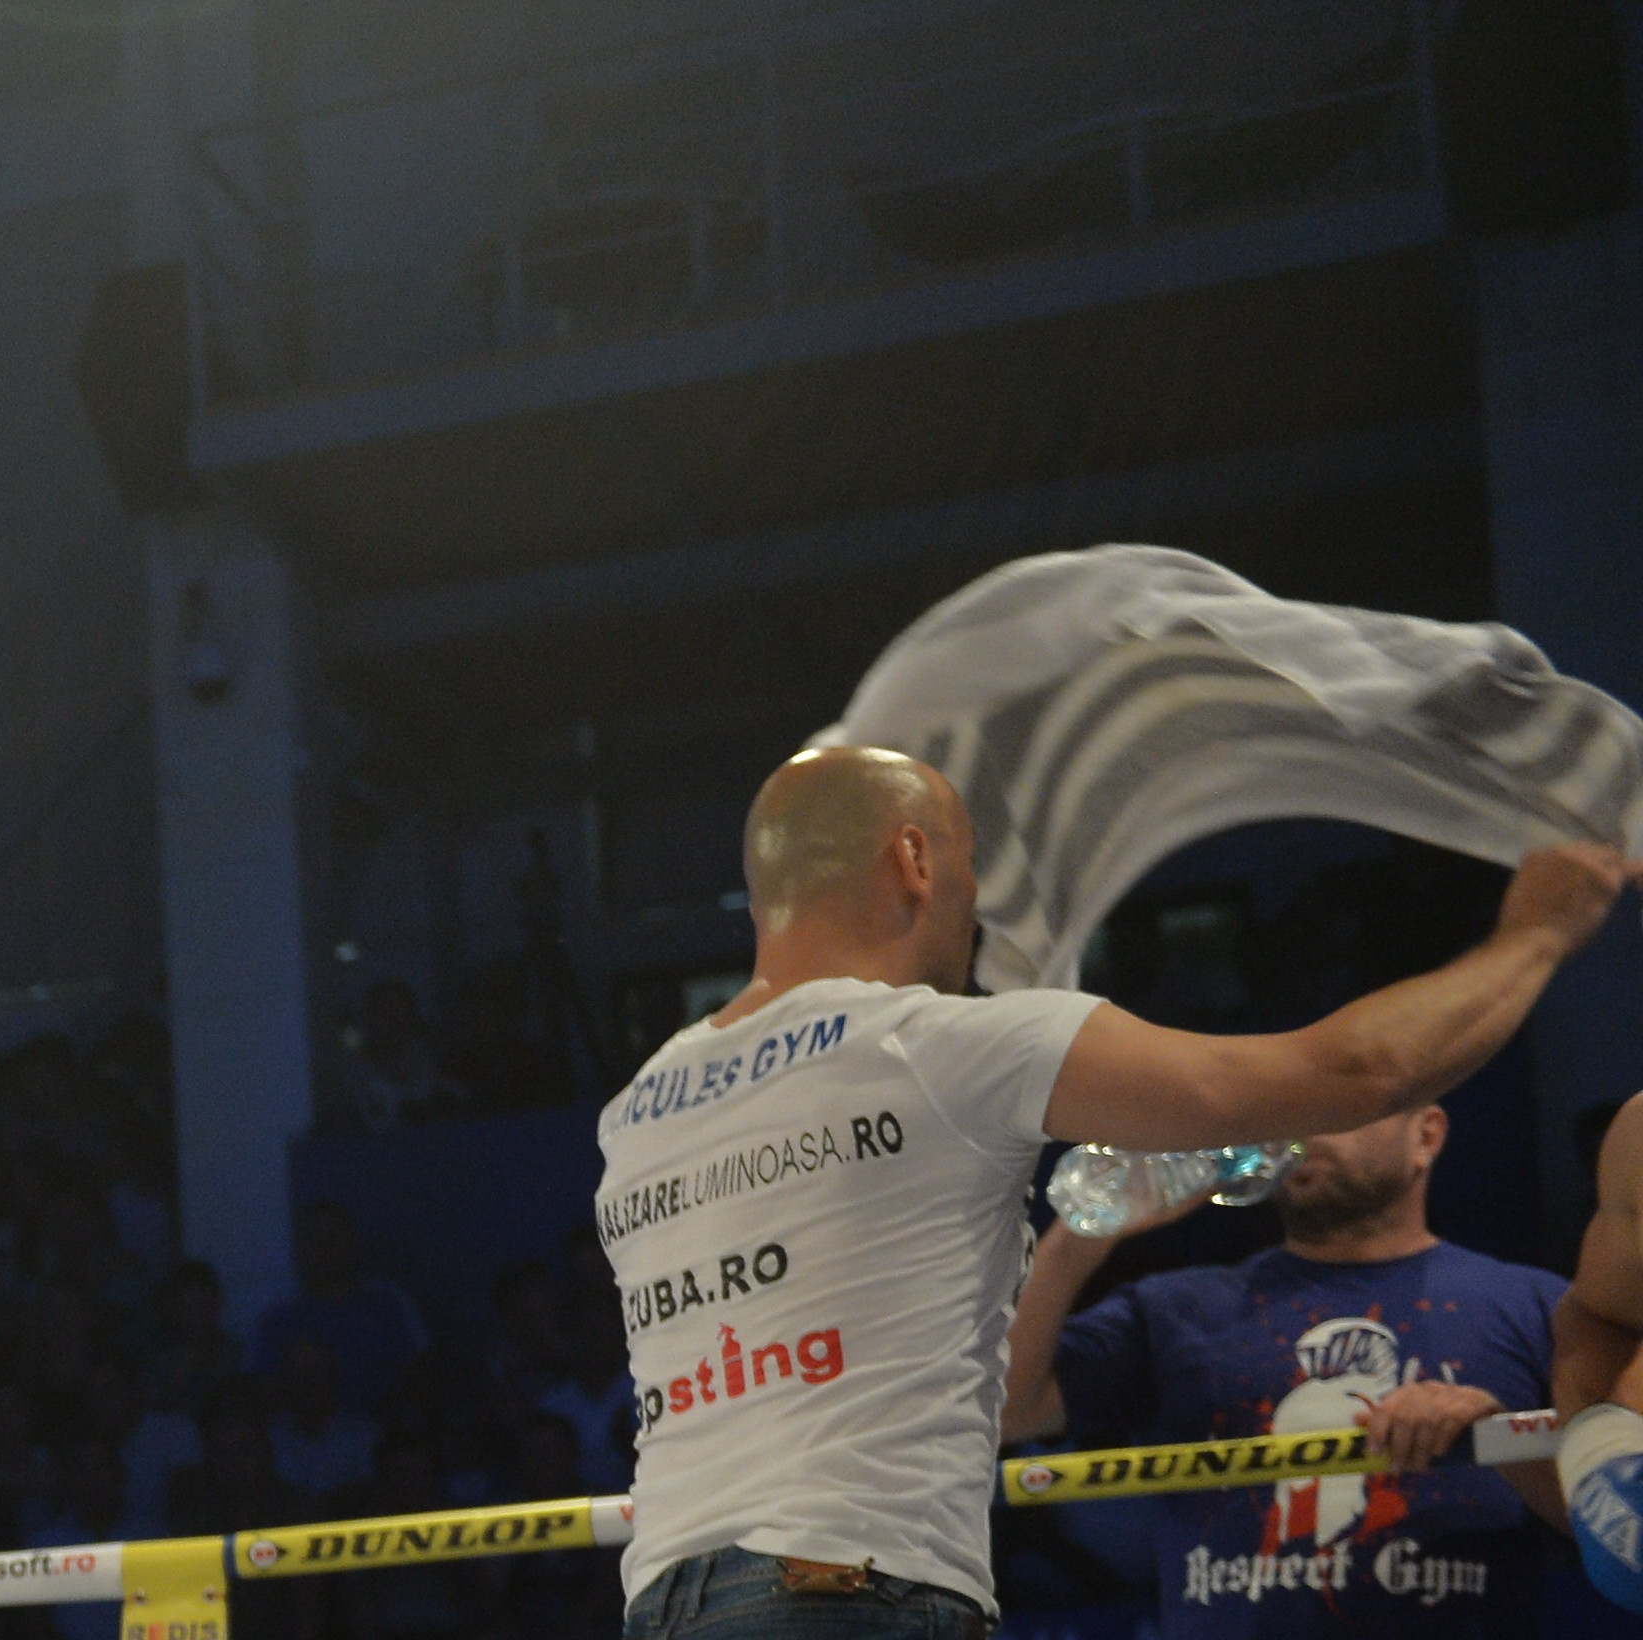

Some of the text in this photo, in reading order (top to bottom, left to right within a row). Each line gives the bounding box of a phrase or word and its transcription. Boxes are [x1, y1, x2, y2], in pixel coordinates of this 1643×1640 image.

[750, 1013, 846, 1085] GYM
[304, 1512, 576, 1564] DUNLOP
[1185, 1538, 1487, 1605] Respect Gym
